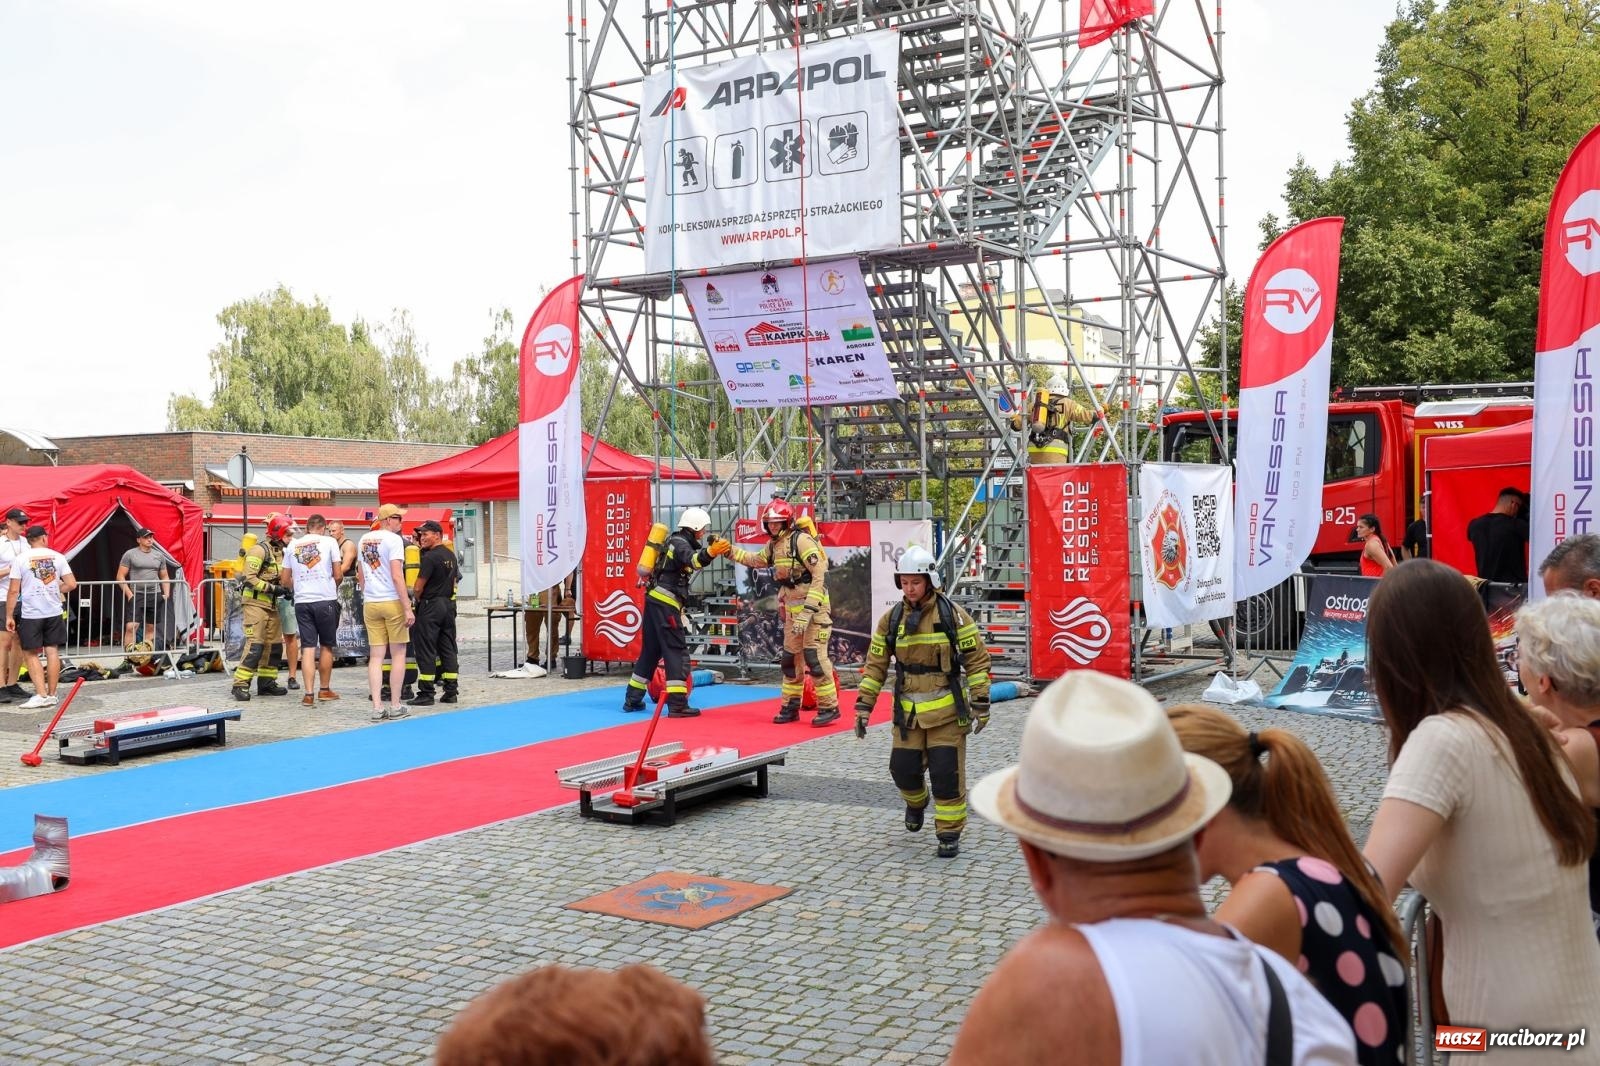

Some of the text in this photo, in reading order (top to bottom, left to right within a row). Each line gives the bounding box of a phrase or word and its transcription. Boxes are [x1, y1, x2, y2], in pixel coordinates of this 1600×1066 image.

[702, 54, 887, 110] ARPAPOL
[658, 199, 883, 235] KOMPLEKSOWA SPRZEDAŻ SPRZĘTU STRAŻACKIEGO
[1262, 288, 1321, 314] RV
[766, 330, 813, 341] KAMPKA
[815, 353, 866, 366] KAREN
[799, 394, 838, 402] TEHNOLOGY
[1433, 420, 1465, 429] WISS
[1573, 347, 1592, 536] ANESSA
[546, 421, 559, 565] VANESSA
[1258, 390, 1288, 567] VANESSA
[606, 492, 615, 578] REKORD
[615, 492, 625, 578] RESCUE
[1062, 481, 1075, 583] REKORD
[1077, 481, 1090, 582] RESCUE
[1249, 503, 1258, 567] RADIO
[1335, 506, 1356, 525] 25
[1554, 493, 1565, 546] ADIO
[536, 513, 544, 566] RADIO
[880, 541, 906, 563] Re
[337, 640, 366, 648] IECZNIE
[871, 645, 881, 654] PSP
[961, 638, 974, 648] PSP
